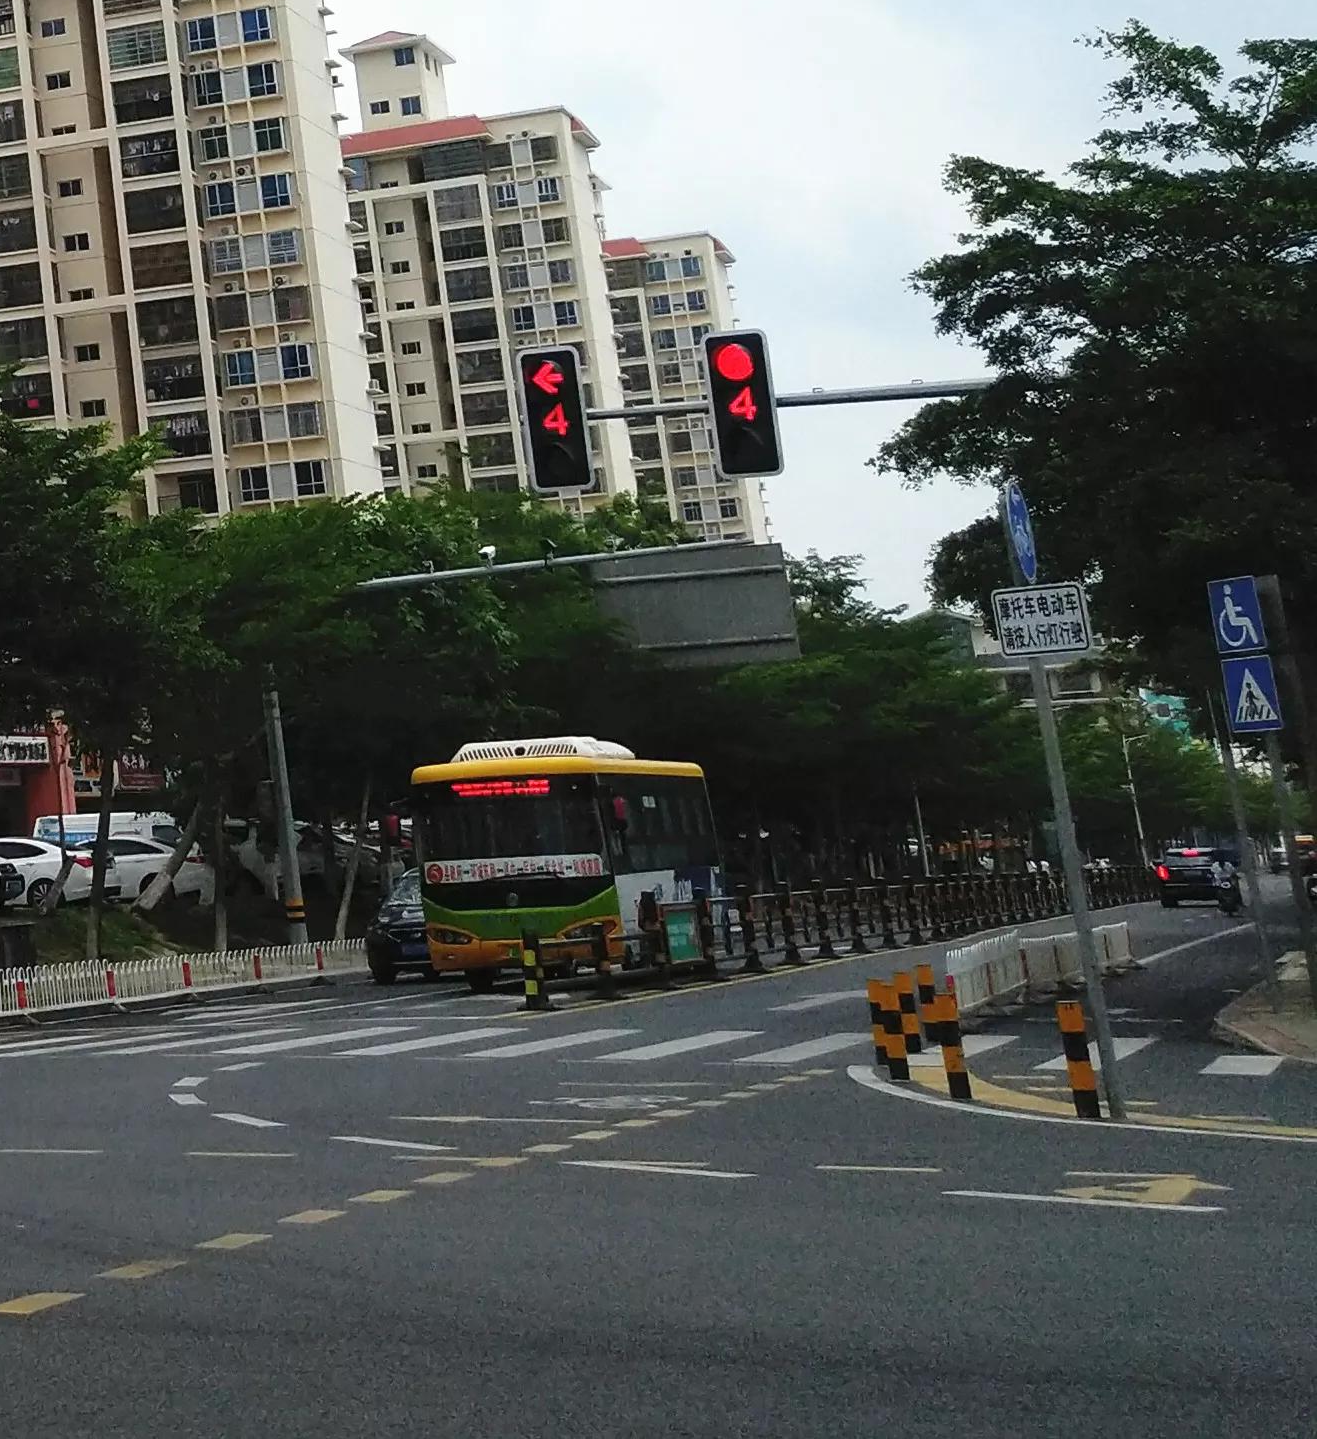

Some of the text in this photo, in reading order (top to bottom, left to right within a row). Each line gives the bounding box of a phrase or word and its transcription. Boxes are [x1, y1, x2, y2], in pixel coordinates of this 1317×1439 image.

[542, 402, 570, 436] 4
[728, 386, 758, 422] 4
[998, 592, 1079, 621] 摩托车电动车
[1003, 621, 1084, 650] 请按人行灯行驶
